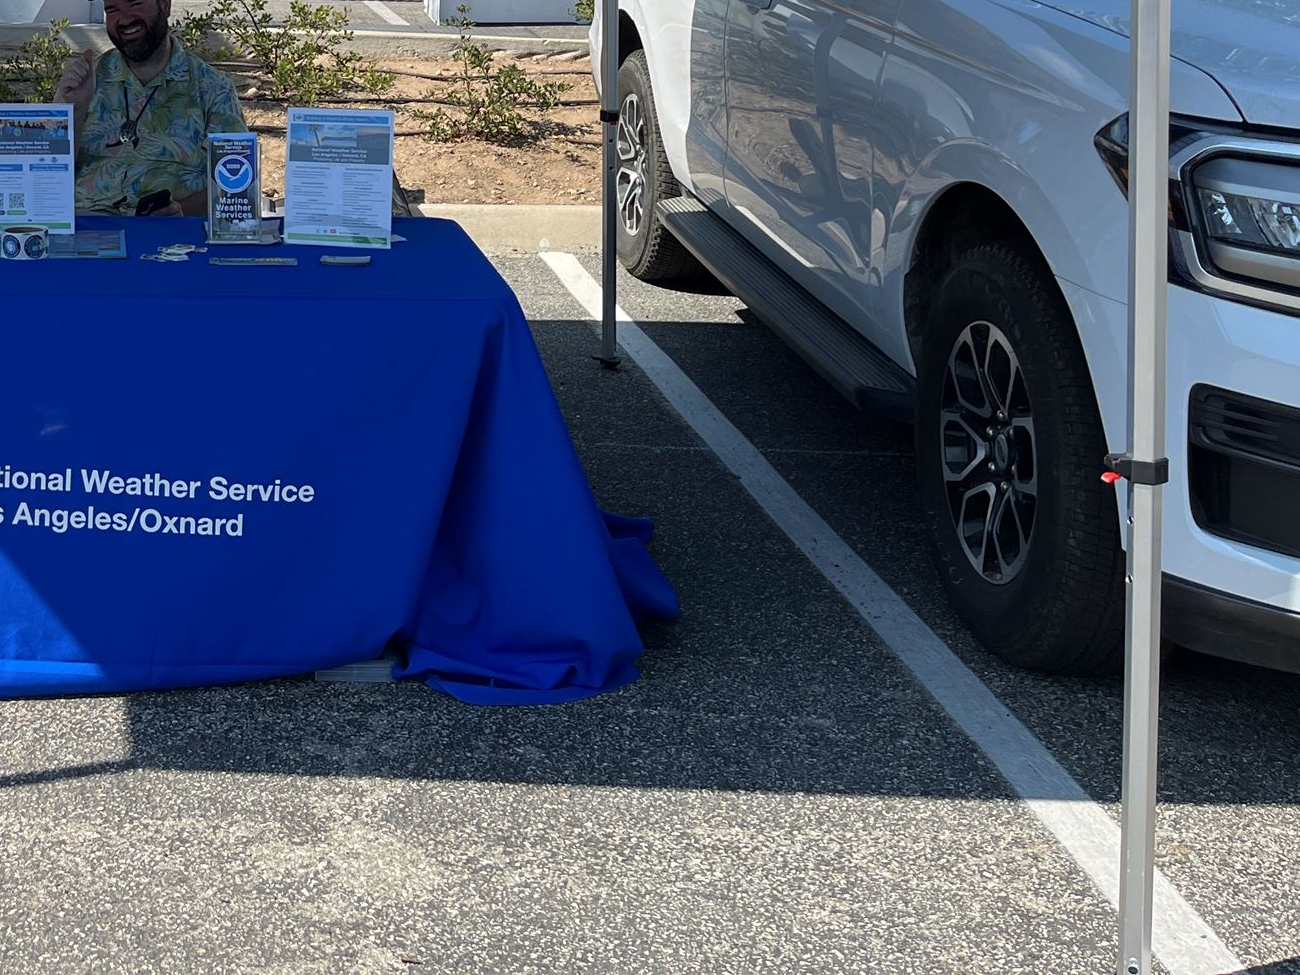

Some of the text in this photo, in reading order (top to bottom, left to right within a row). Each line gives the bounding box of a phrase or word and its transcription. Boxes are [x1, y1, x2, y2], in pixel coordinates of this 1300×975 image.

[219, 197, 249, 205] Marine
[215, 204, 252, 212] Weather
[215, 211, 253, 219] Services
[81, 469, 201, 499] Weather
[209, 476, 315, 503] Service
[12, 501, 244, 537] Angeles/Oxnard
